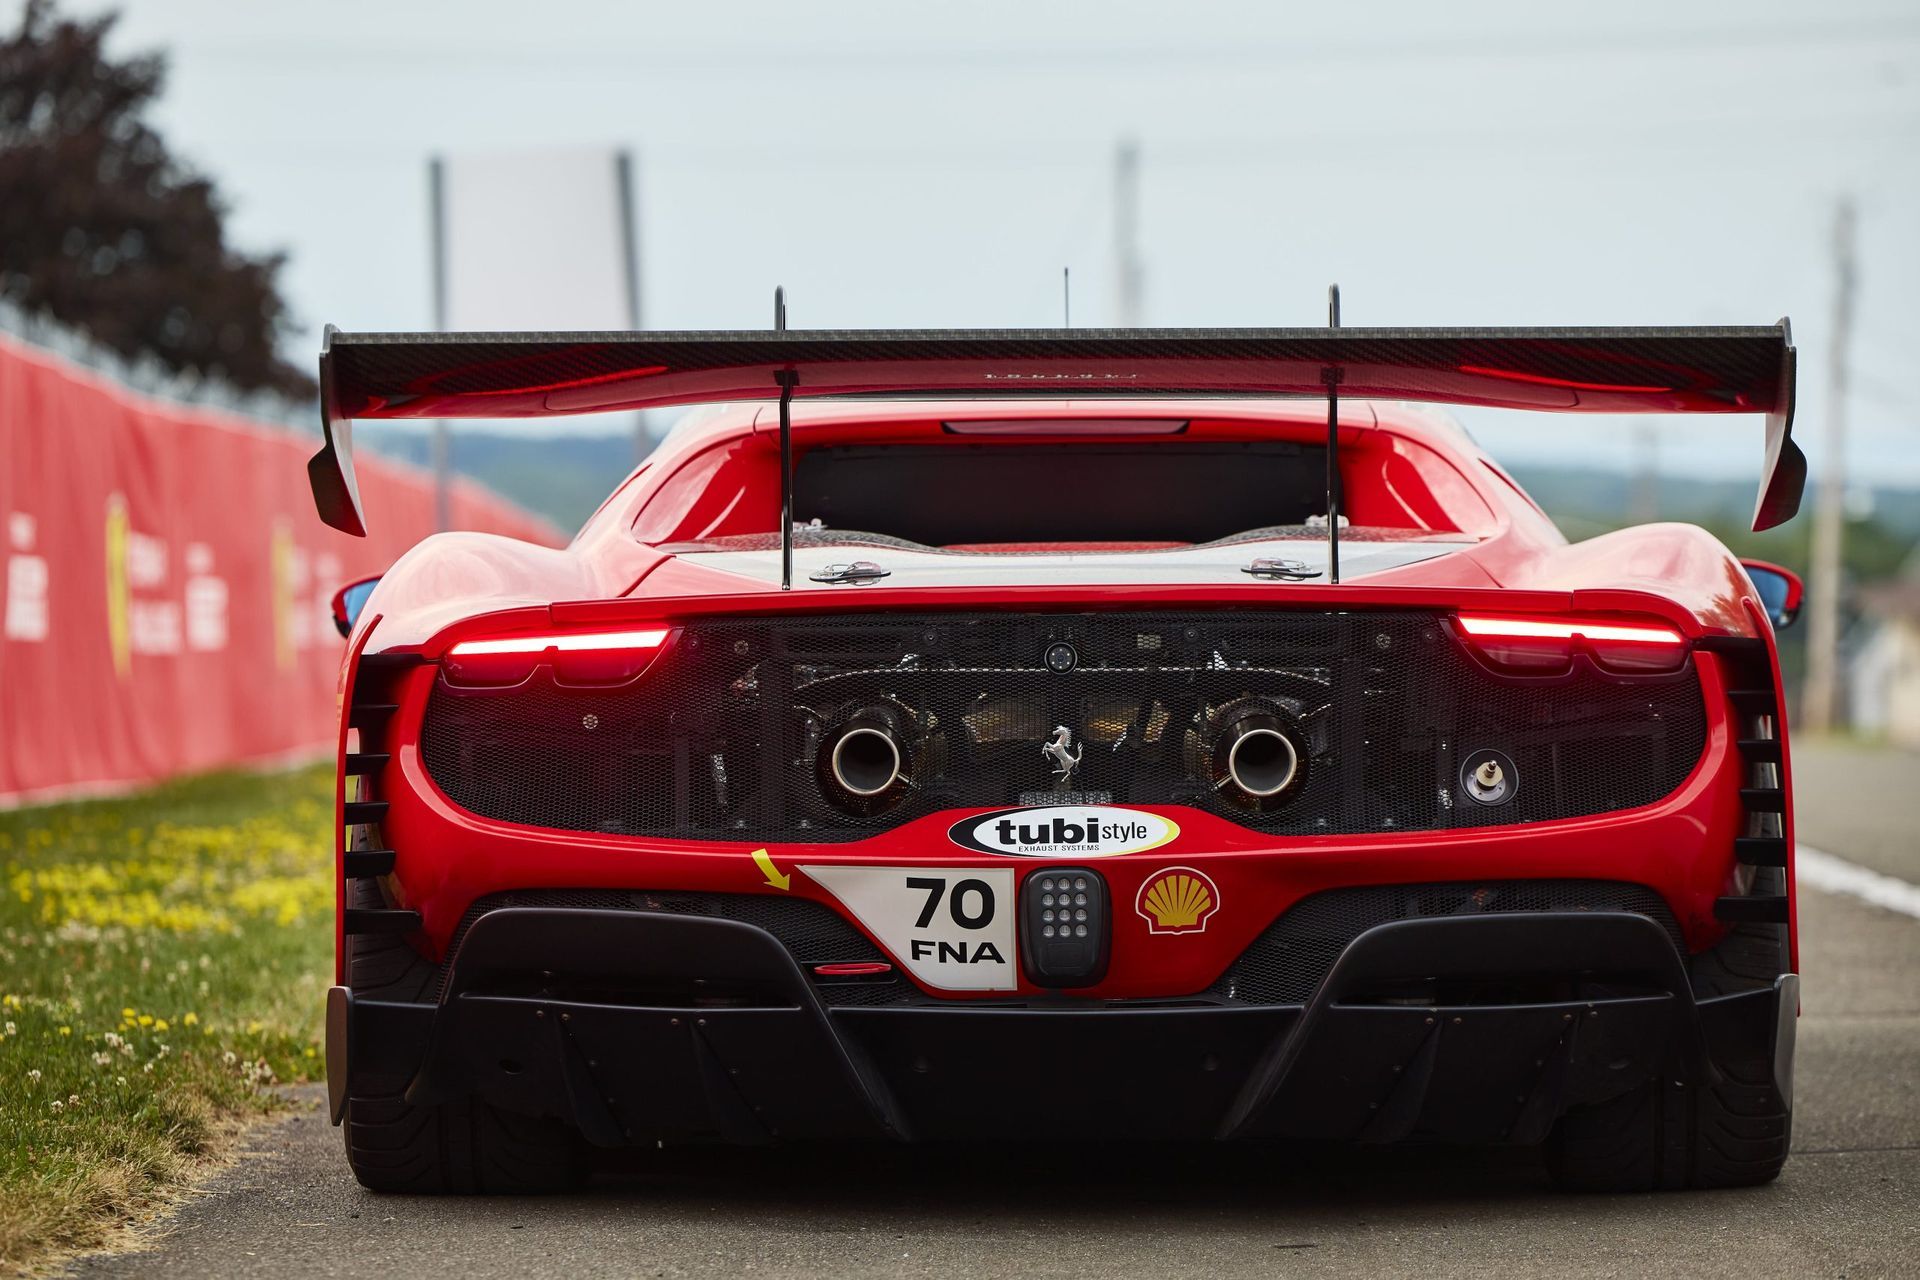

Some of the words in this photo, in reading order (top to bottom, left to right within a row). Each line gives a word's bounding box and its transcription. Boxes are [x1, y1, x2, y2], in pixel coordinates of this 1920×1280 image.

[995, 817, 1099, 845] tubi
[1101, 821, 1147, 843] style
[905, 877, 996, 930] 70
[910, 939, 1006, 965] FNA
